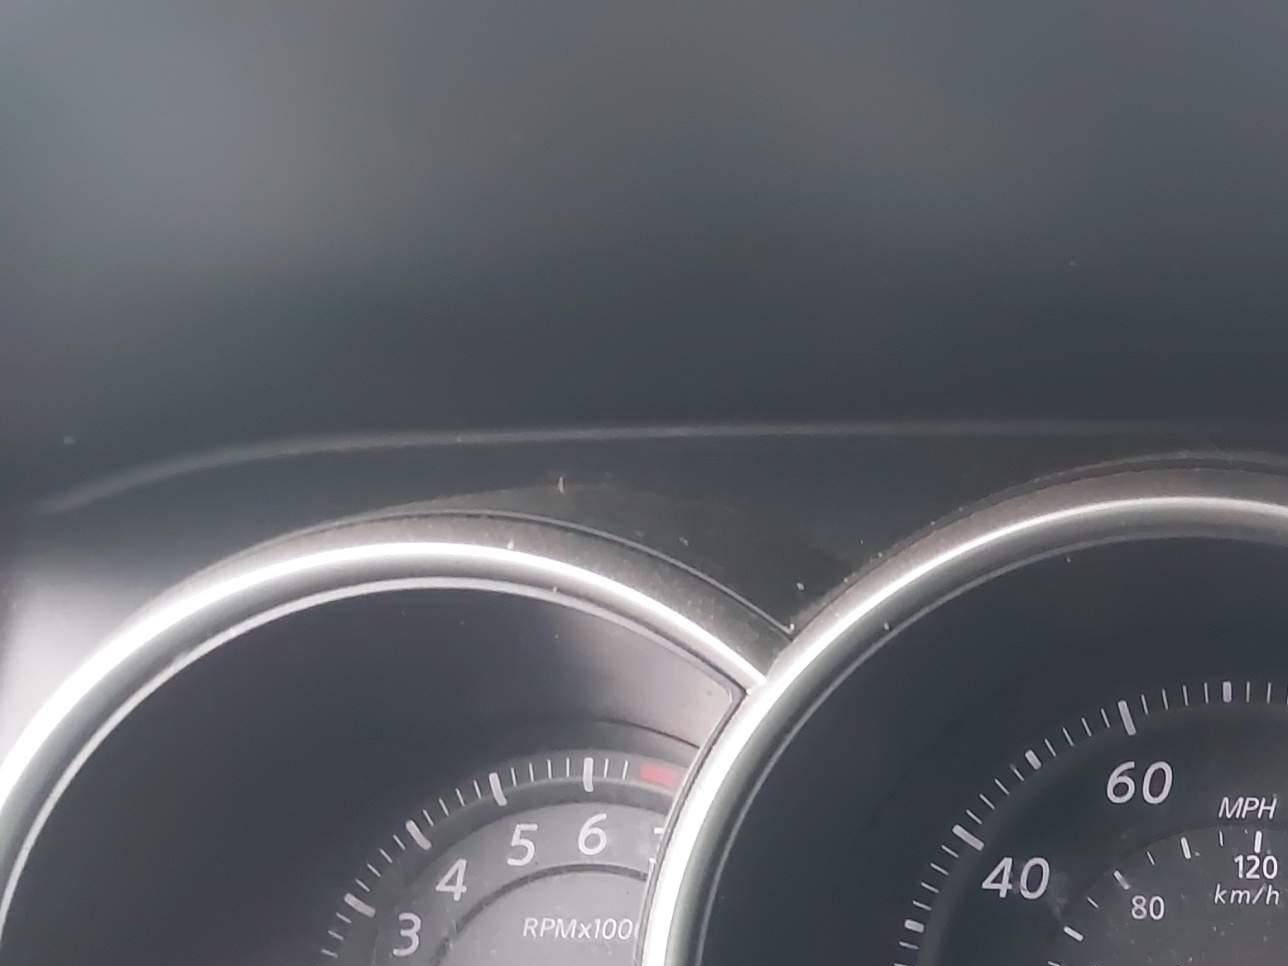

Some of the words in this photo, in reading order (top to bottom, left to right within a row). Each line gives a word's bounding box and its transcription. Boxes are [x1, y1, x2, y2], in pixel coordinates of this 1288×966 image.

[1106, 761, 1173, 804] 60
[1218, 797, 1277, 820] MPH
[507, 824, 538, 866] 5
[578, 813, 607, 855] 6
[436, 859, 467, 900] 4
[982, 857, 1049, 900] 40
[1234, 855, 1278, 879] 120
[1131, 895, 1164, 920] 80
[1214, 884, 1280, 906] km/h
[393, 913, 421, 956] 3
[523, 918, 640, 940] RPMx100
